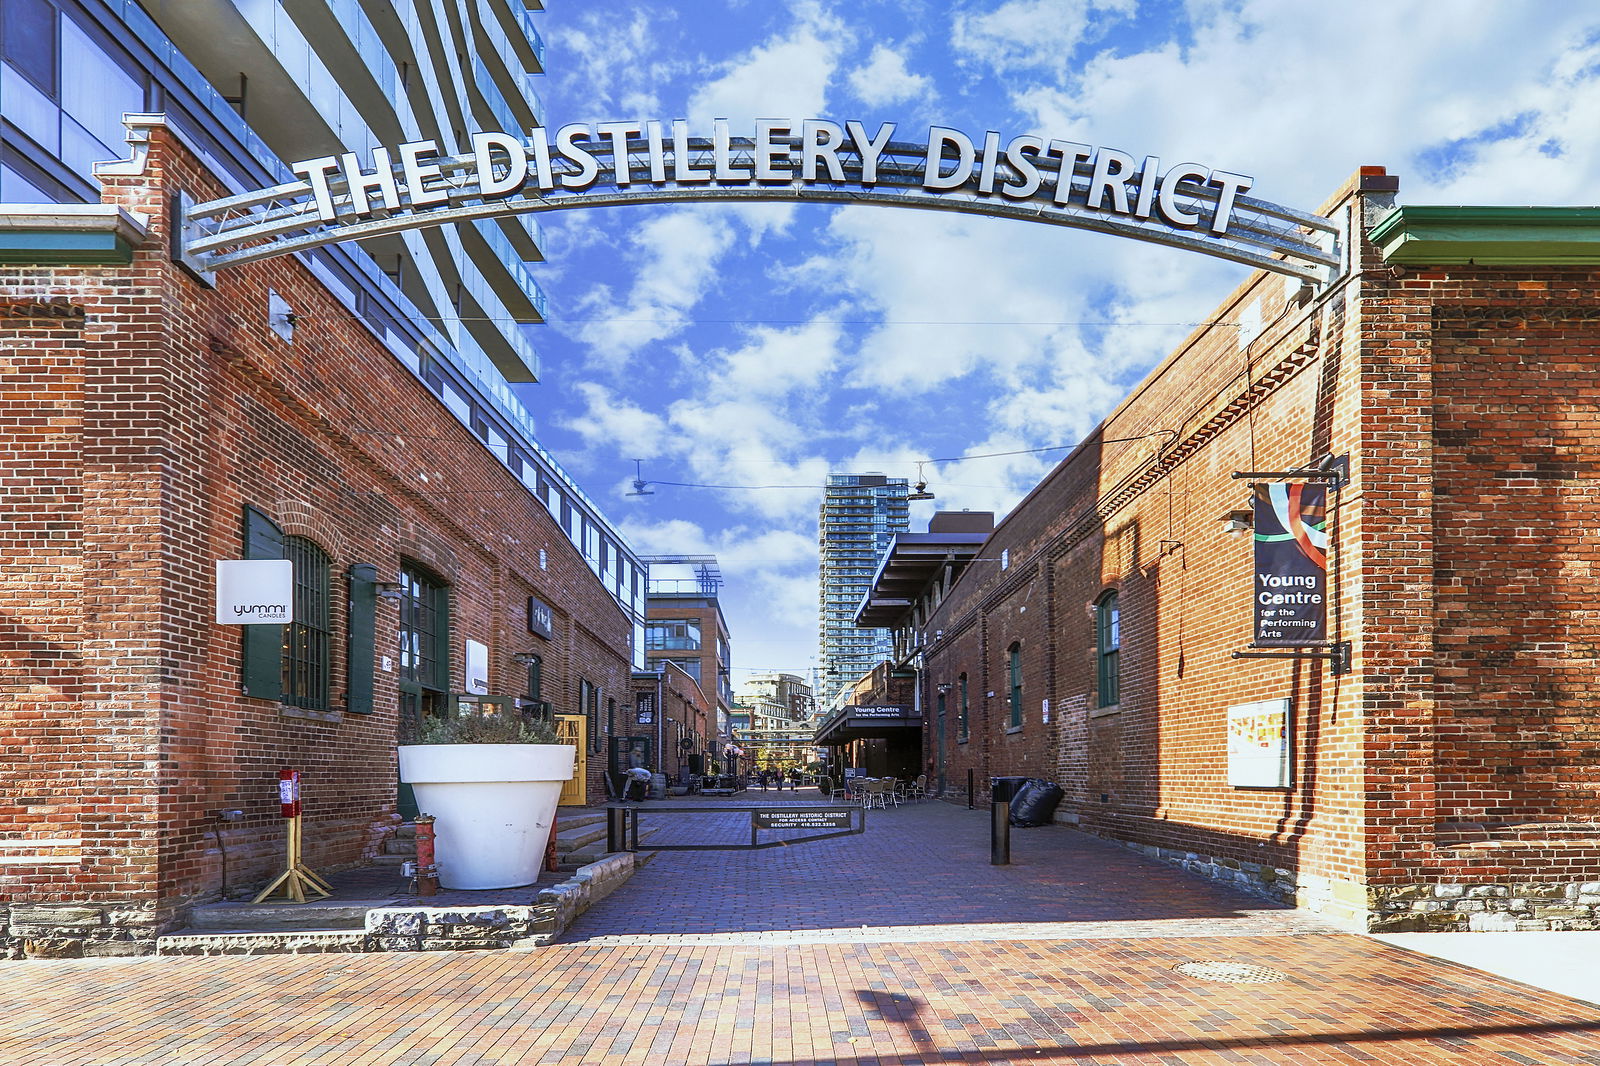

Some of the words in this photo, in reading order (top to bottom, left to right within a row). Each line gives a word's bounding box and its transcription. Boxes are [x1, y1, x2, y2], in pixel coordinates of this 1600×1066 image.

[291, 139, 449, 223] THE
[472, 117, 899, 196] DISTILLERY
[921, 125, 1255, 238] DISTRICT
[1259, 573, 1316, 589] Young
[1258, 591, 1322, 605] Centre
[233, 604, 286, 617] yummi
[1260, 609, 1276, 617] for
[1278, 608, 1295, 616] the
[1260, 619, 1317, 628] Performing
[1260, 630, 1282, 638] Arts
[854, 706, 876, 714] Young
